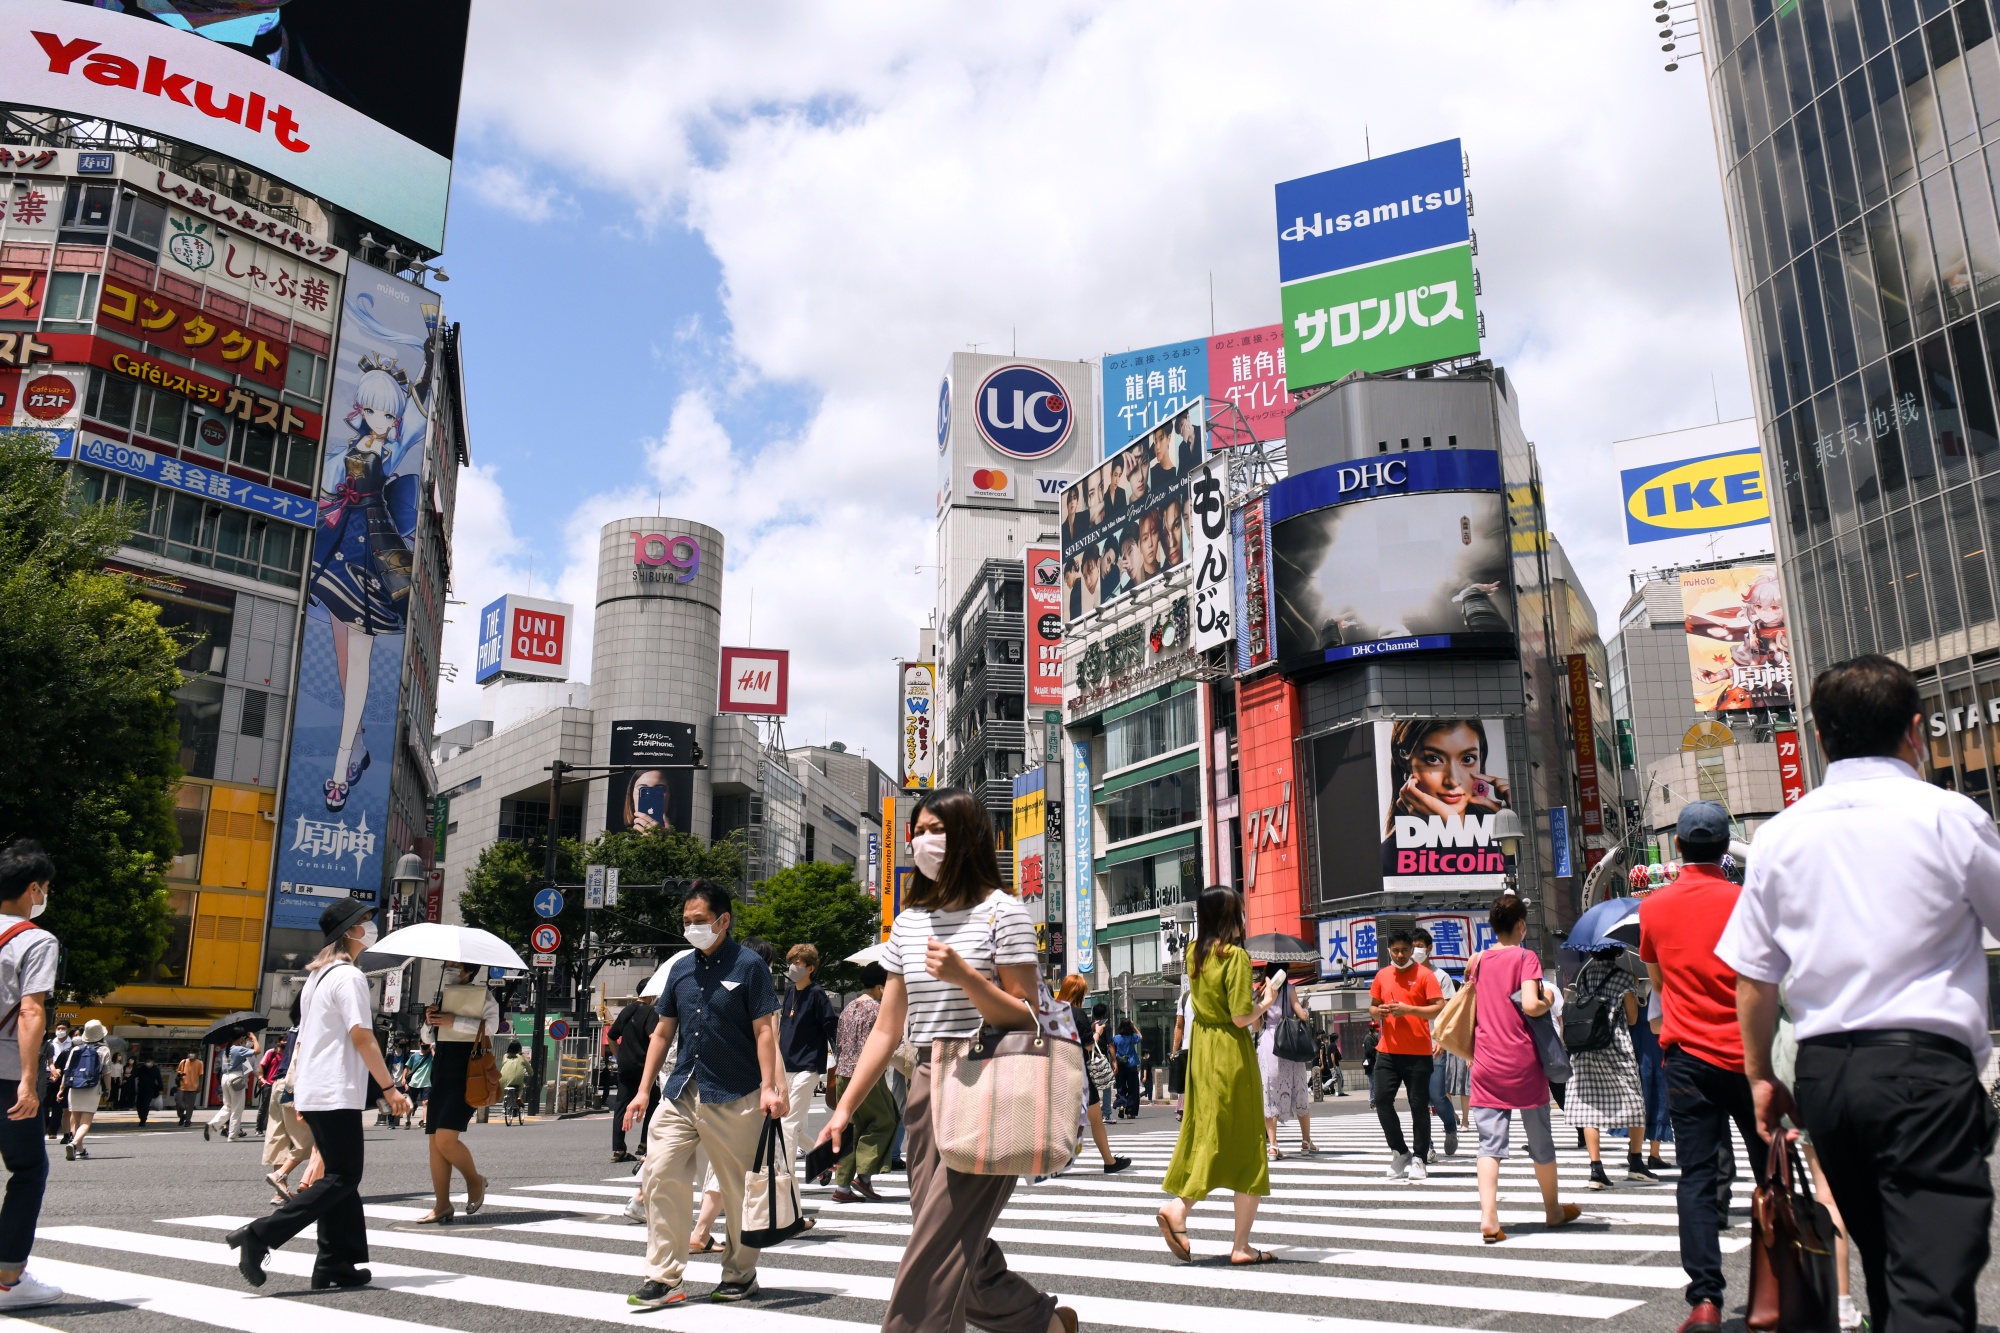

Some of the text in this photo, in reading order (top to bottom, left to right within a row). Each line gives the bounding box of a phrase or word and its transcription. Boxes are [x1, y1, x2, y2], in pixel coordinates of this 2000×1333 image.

[30, 30, 311, 153] Yakult
[81, 156, 110, 169] 寿司
[0, 190, 48, 226] 葉
[158, 171, 339, 262] しゃぶしゃぶバイキング
[1280, 187, 1462, 242] Hisamitsu
[225, 243, 330, 312] しゃぶ葉
[377, 283, 410, 303] miHoYo
[101, 283, 280, 371] コンタクト
[1294, 280, 1464, 354] サロンパス
[1110, 345, 1201, 370] のど、直接、うるおう
[29, 394, 70, 408] ガスト
[1125, 365, 1187, 402] 龍角散
[225, 387, 304, 434] ガスト
[89, 440, 144, 469] AEON
[1337, 460, 1407, 493] DHC
[1644, 470, 1768, 517] IKE
[630, 531, 701, 583] 109
[1065, 527, 1101, 558] SEVENTEEN
[1193, 466, 1230, 638] もんじゃ
[632, 570, 674, 583] SHIBUYA
[1683, 577, 1716, 587] miHoYo
[486, 608, 500, 640] THE
[519, 615, 556, 637] UNI
[477, 634, 502, 672] PRIME
[517, 636, 557, 657] QLO
[1352, 639, 1419, 656] DHC Channel
[738, 669, 772, 692] H&M
[1571, 658, 1591, 756] クスリのことなら
[1779, 742, 1802, 801] カラオ
[289, 809, 376, 882] 原神
[1076, 770, 1089, 886] サマーフルーツギフト
[296, 859, 346, 872] Genshin
[869, 843, 877, 863] LABI
[884, 847, 892, 895] Matsumoto
[1397, 848, 1505, 874] Bitcoin
[592, 868, 603, 905] 渋谷駅前
[1020, 854, 1044, 899] 薬
[428, 895, 439, 921] アコム
